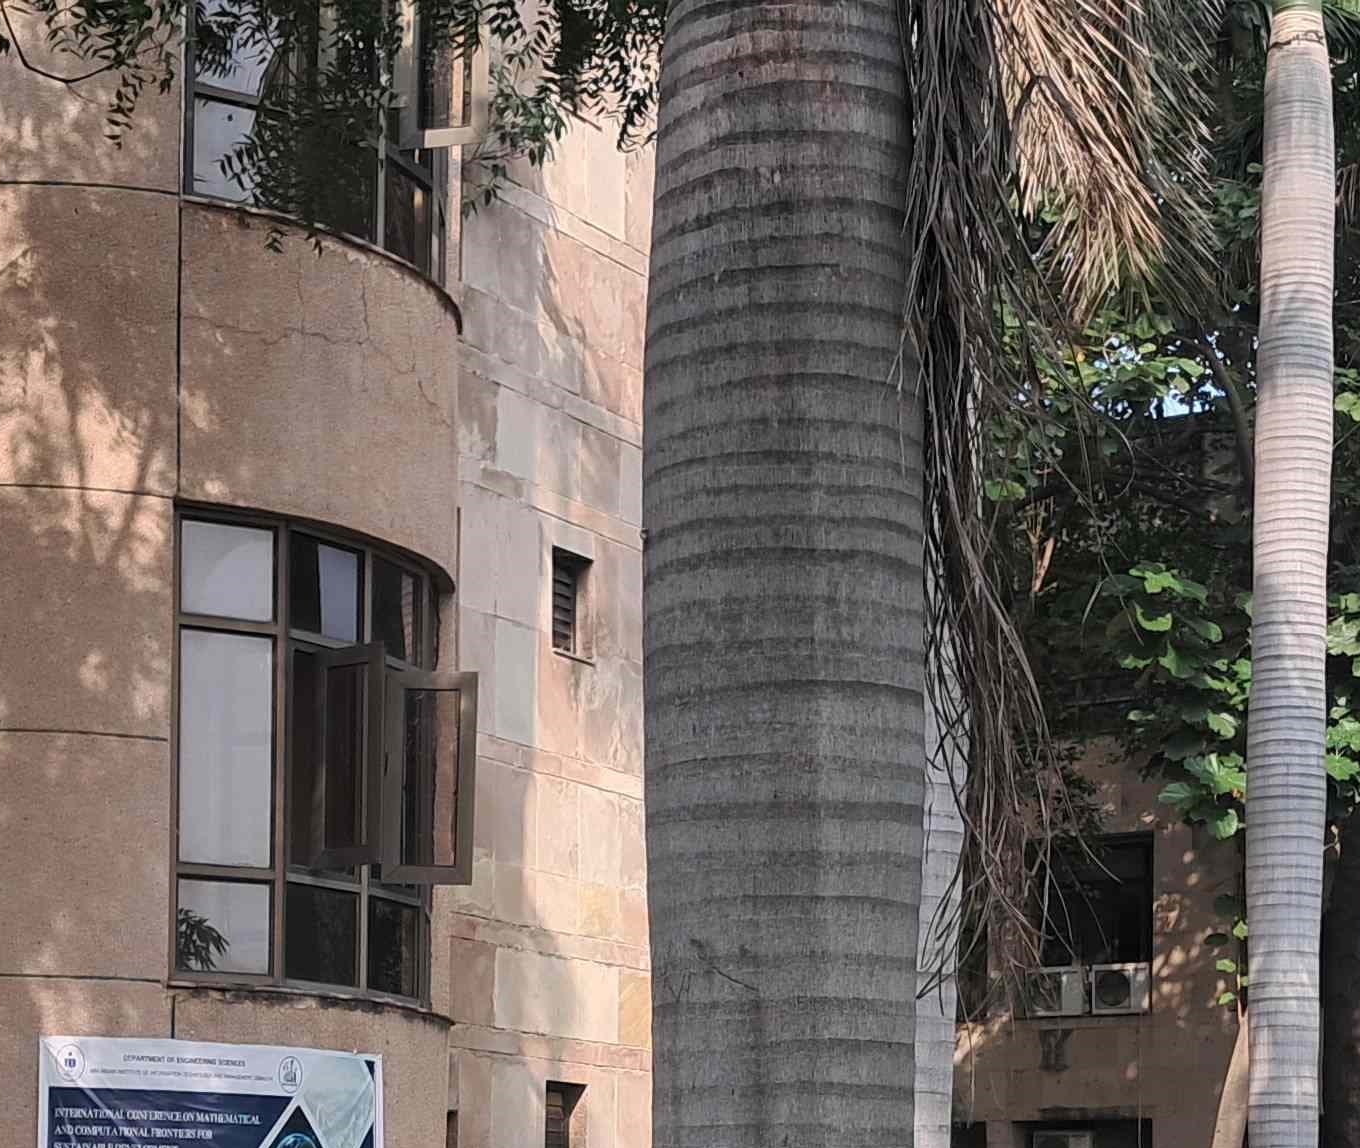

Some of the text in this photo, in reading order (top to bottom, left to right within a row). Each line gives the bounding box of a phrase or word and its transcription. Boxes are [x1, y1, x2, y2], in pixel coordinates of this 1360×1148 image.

[54, 1107, 262, 1125] INTERNATIONAL CONFERENCE ON MATHEMATICAL
[54, 1124, 213, 1139] AND COMPUTATIONAL FRONTIERS FOR
